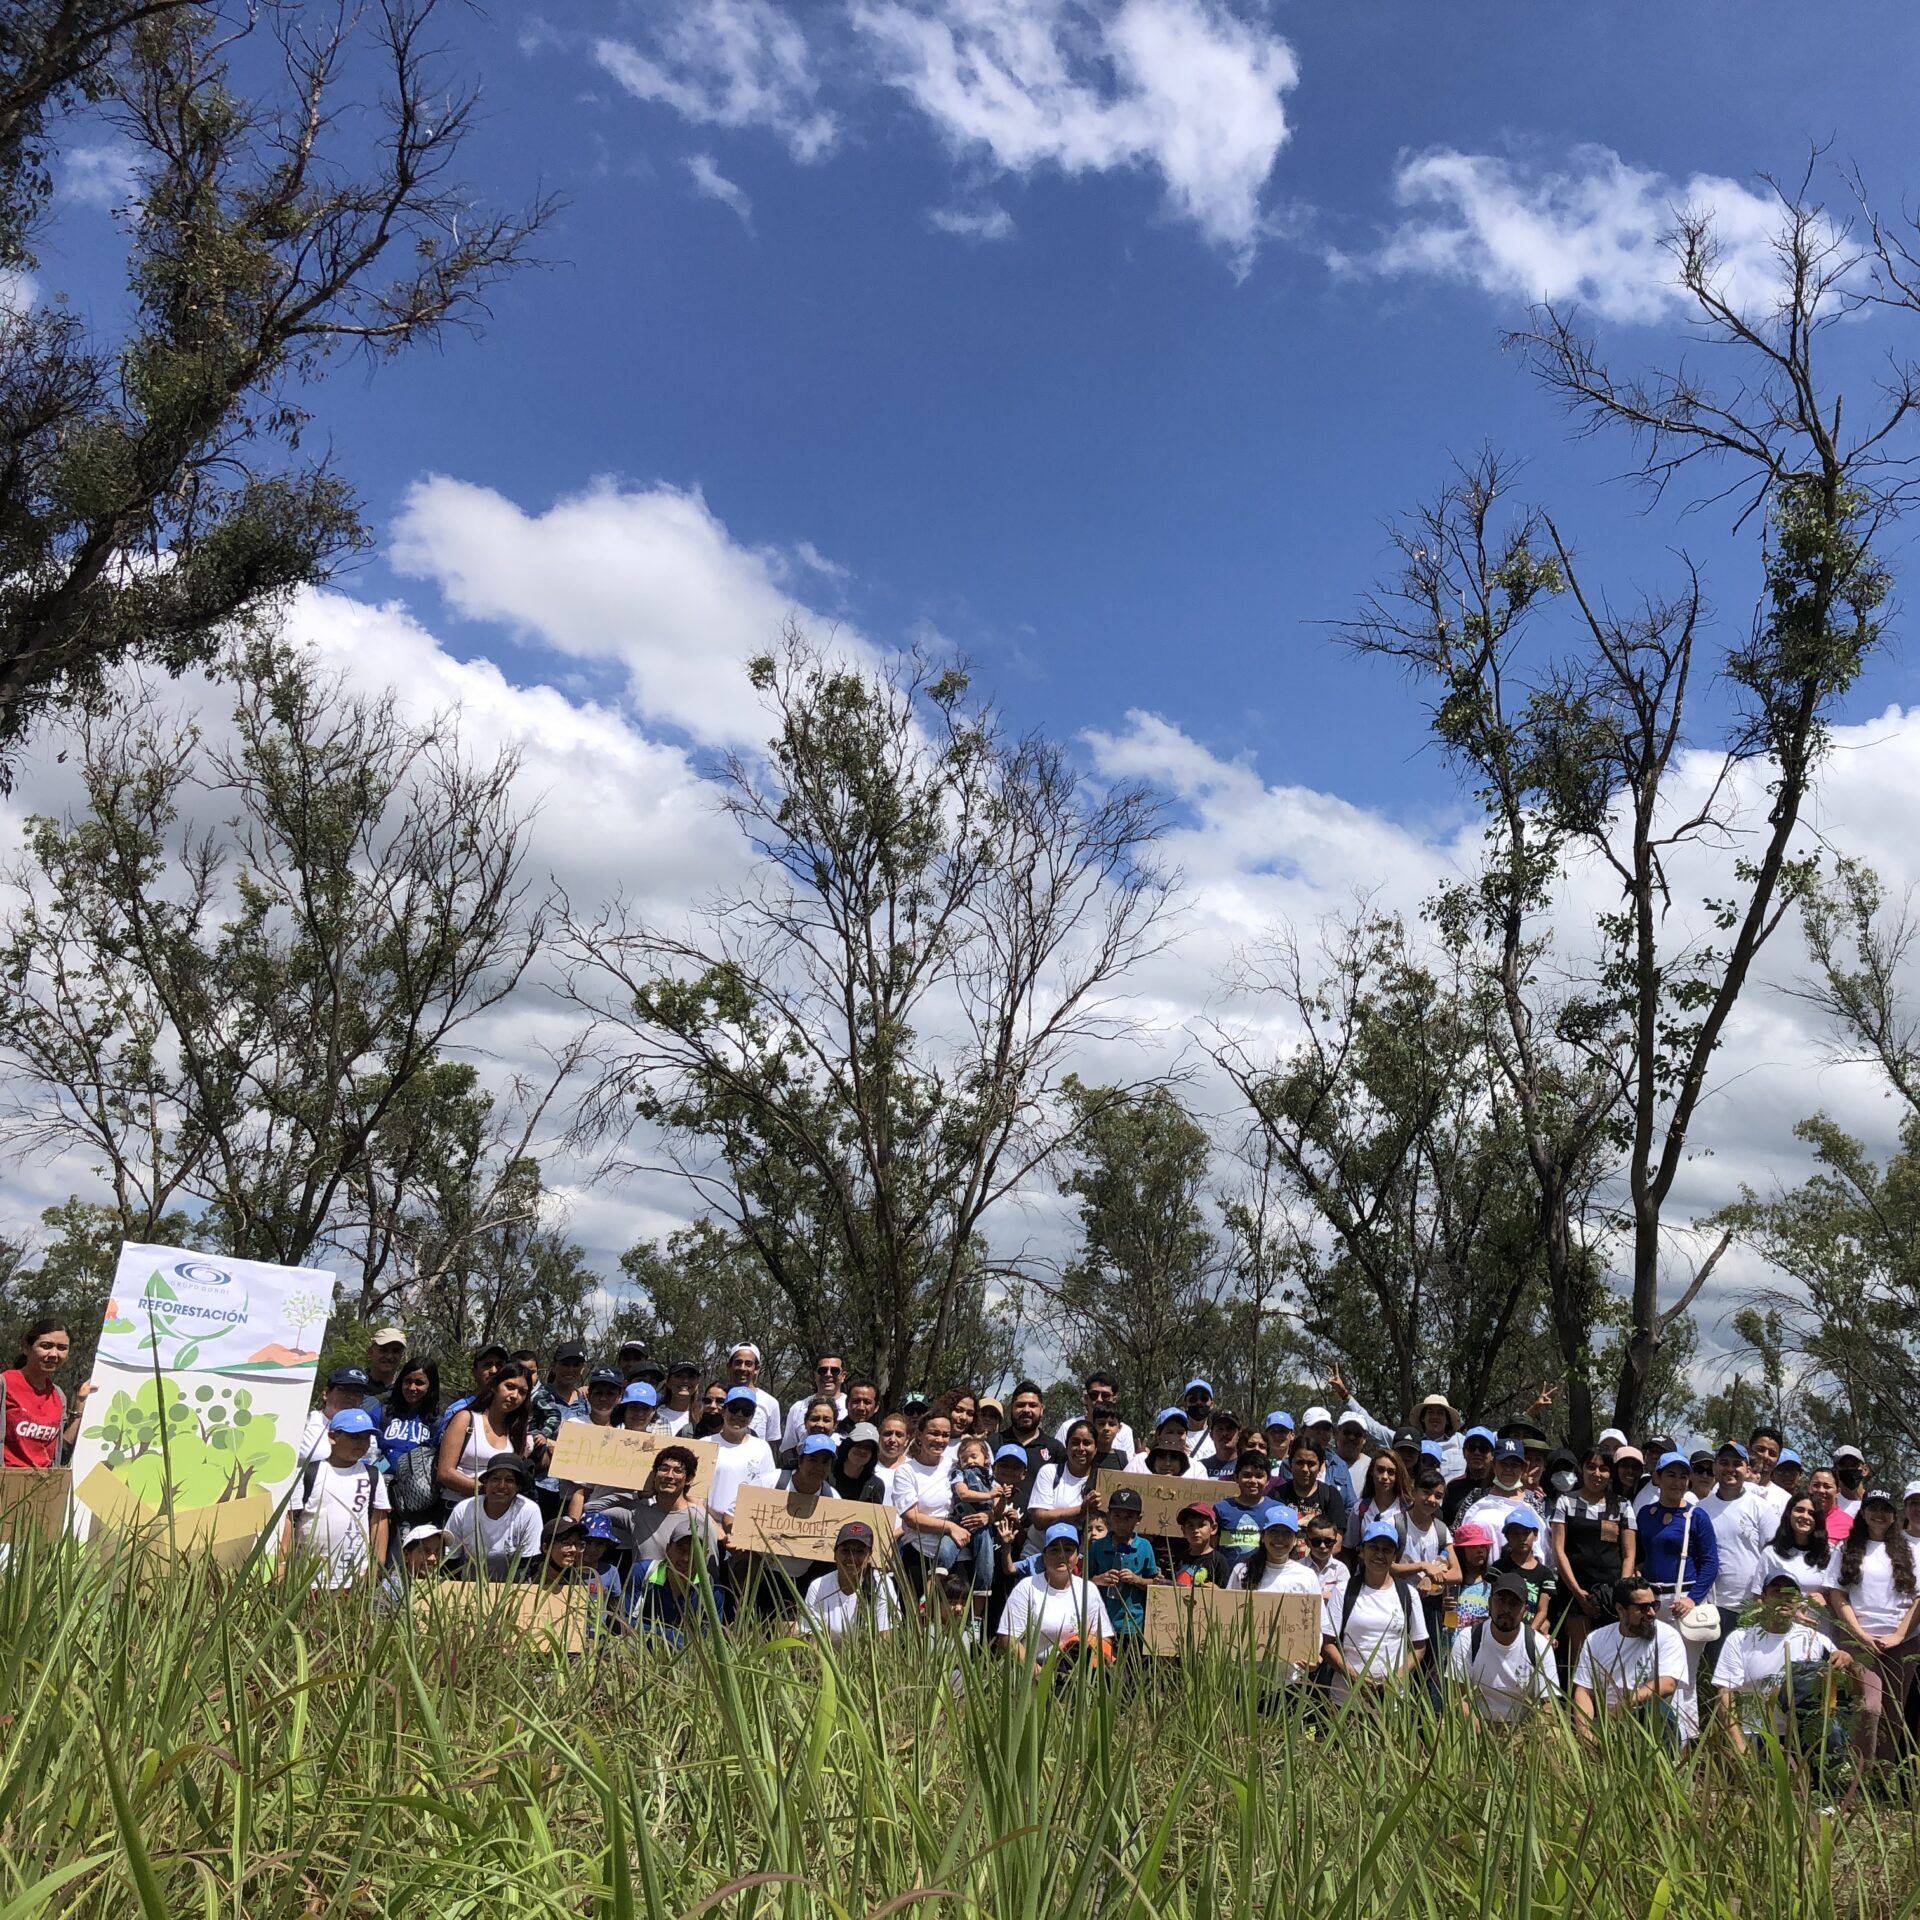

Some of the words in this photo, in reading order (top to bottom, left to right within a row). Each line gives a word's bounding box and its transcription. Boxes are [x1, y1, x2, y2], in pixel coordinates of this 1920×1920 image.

[138, 1298, 249, 1325] REFORESTACIÓN
[383, 1417, 431, 1445] GAP
[1209, 1468, 1235, 1477] TOMM
